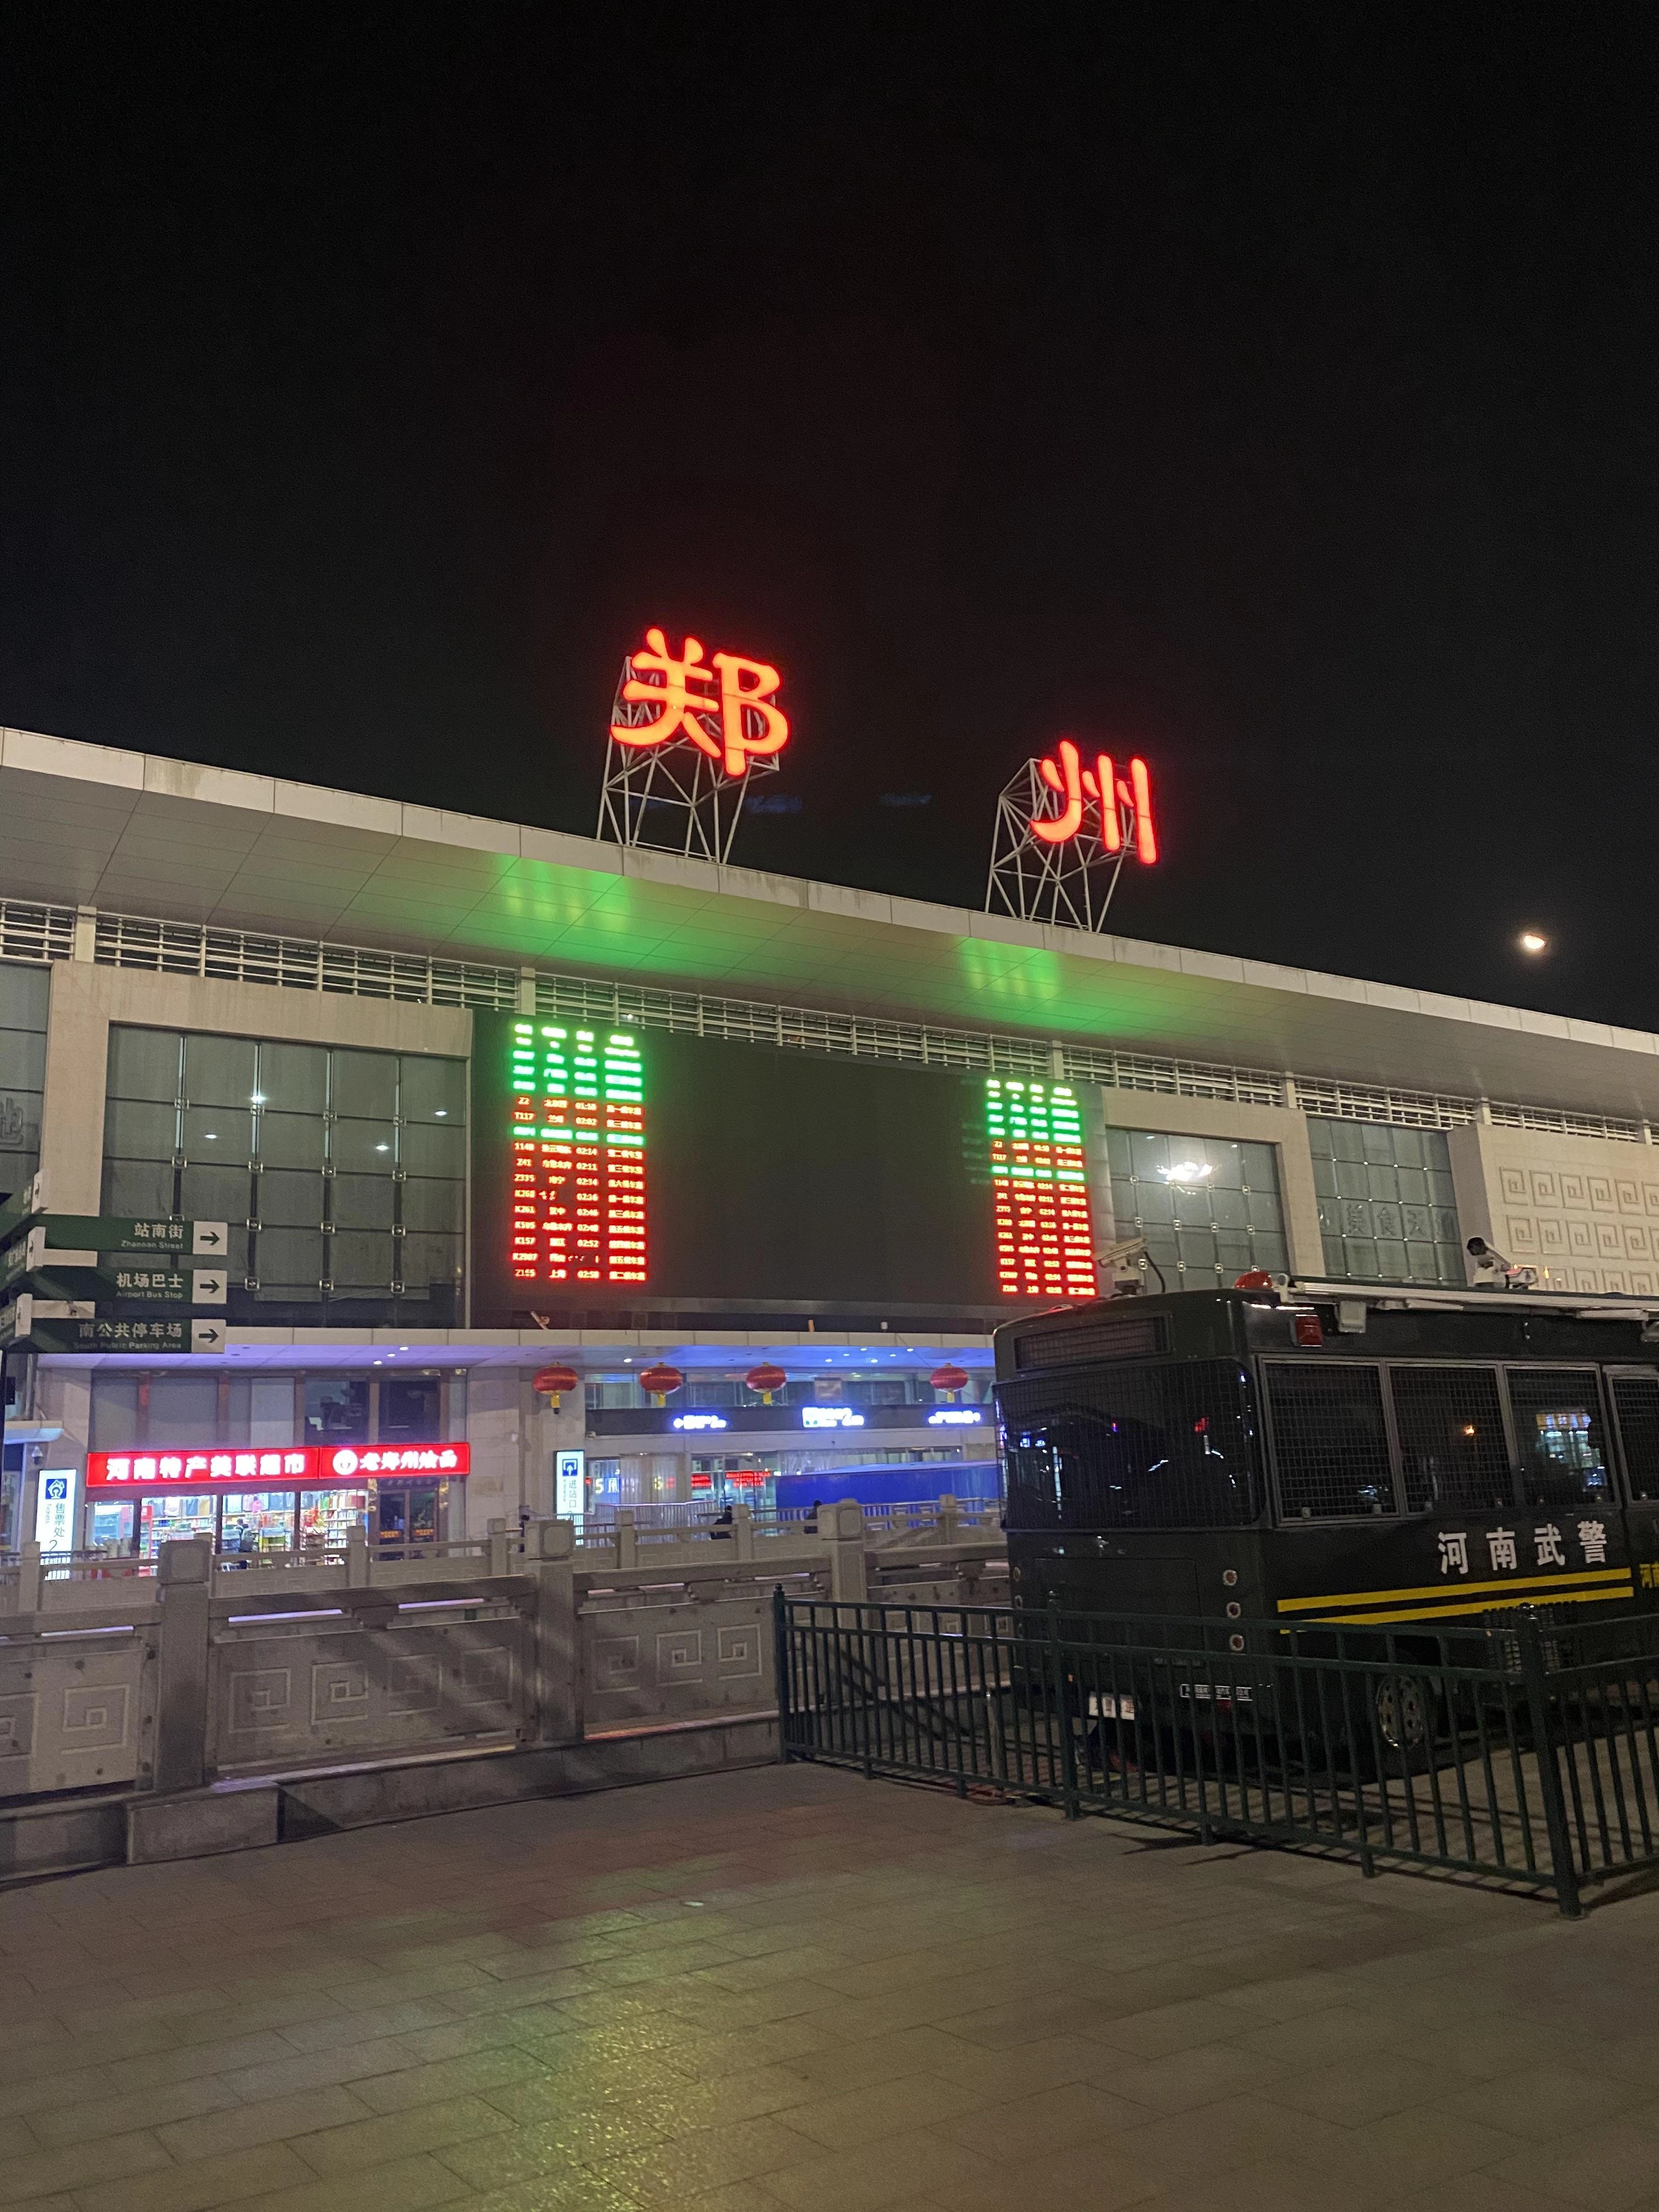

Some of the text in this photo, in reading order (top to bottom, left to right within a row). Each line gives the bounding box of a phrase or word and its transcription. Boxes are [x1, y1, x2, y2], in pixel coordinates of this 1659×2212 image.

[134, 1222, 184, 1239] 站南街
[121, 1240, 157, 1248] Zhannan
[116, 1272, 184, 1289] 机场巴士
[116, 1290, 145, 1299] Airport
[165, 1291, 183, 1300] Stop
[79, 1323, 182, 1338] 南公共停车场
[129, 1342, 160, 1351] Parking
[568, 1479, 577, 1508] 进站口
[53, 1503, 65, 1538] 售票处
[1437, 1521, 1606, 1575] 河南武警
